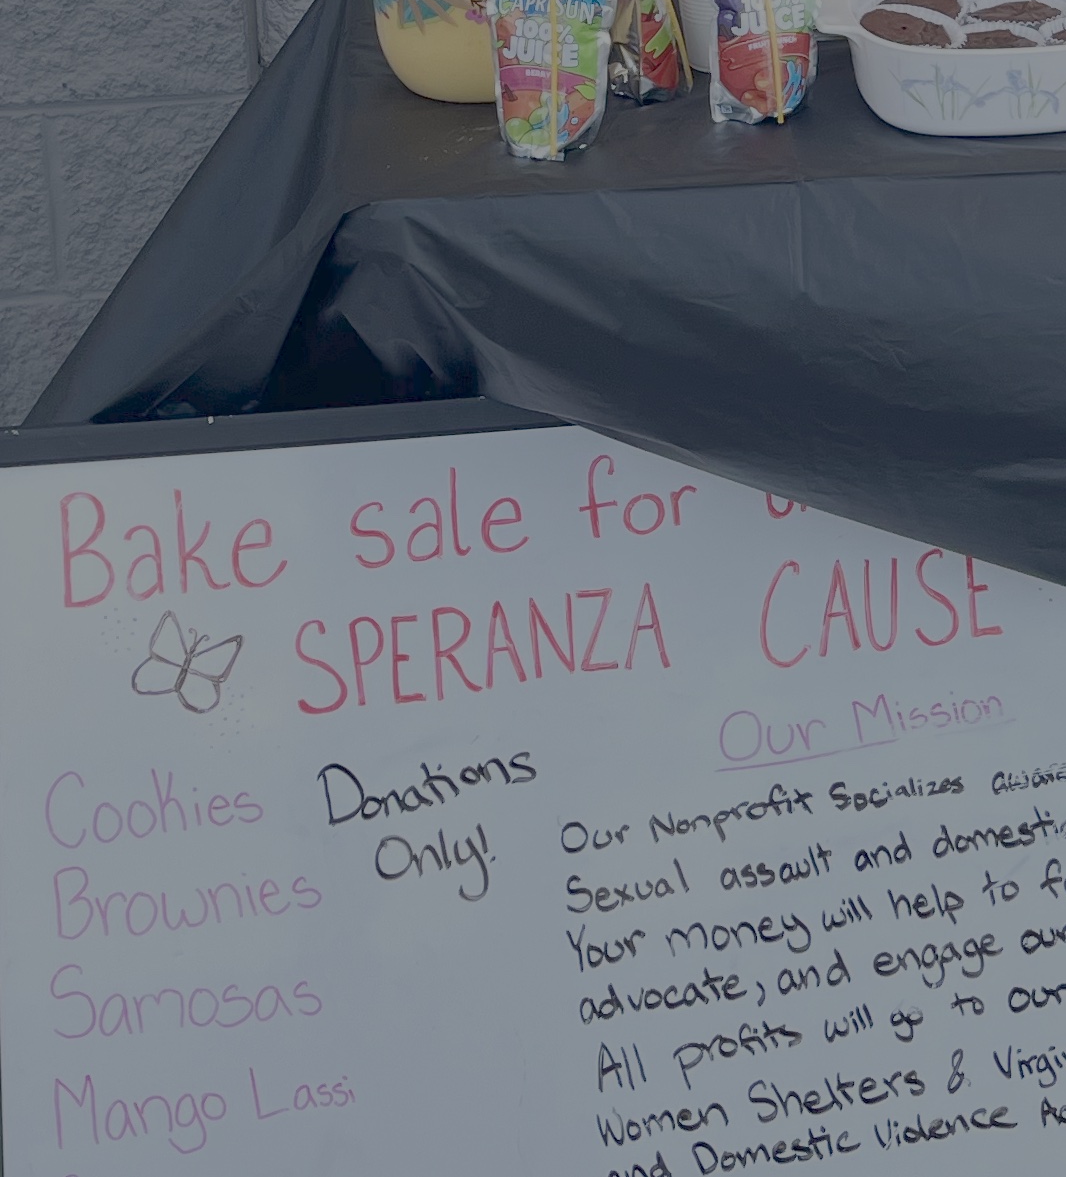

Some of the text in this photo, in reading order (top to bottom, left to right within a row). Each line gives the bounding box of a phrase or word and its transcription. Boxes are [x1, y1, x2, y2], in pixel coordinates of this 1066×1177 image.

[502, 35, 579, 67] JUICE
[515, 18, 575, 44] 100%
[731, 4, 805, 36] JUCE
[59, 454, 697, 608] Bake sale for
[295, 548, 1004, 715] SPERANZA CAUSE
[719, 692, 1004, 762] Our Mission
[45, 768, 264, 850] Cookies
[316, 751, 538, 826] Donations
[560, 821, 630, 854] Our
[649, 783, 814, 843] Nonprofit
[375, 824, 497, 901] Only!
[565, 857, 691, 914] Sexual
[719, 842, 832, 891] assault
[854, 831, 912, 872] and
[53, 867, 323, 940] Brownies
[566, 924, 646, 972] Your
[664, 911, 812, 956] money
[822, 894, 873, 932] will
[888, 884, 965, 924] help
[982, 870, 1020, 906] to
[50, 964, 323, 1039] Samosas
[579, 967, 766, 1024] advocate,
[777, 948, 851, 994] and
[873, 931, 1004, 989] engage
[598, 1041, 647, 1092] All
[672, 1020, 802, 1090] profits
[824, 1003, 874, 1044] will
[889, 1005, 924, 1042] go
[950, 991, 985, 1018] to
[53, 1067, 356, 1154] Mango Lassi
[596, 1102, 729, 1147] Women
[747, 1069, 926, 1123] Shelters
[946, 1048, 967, 1095] &
[691, 1125, 862, 1175] Domestic
